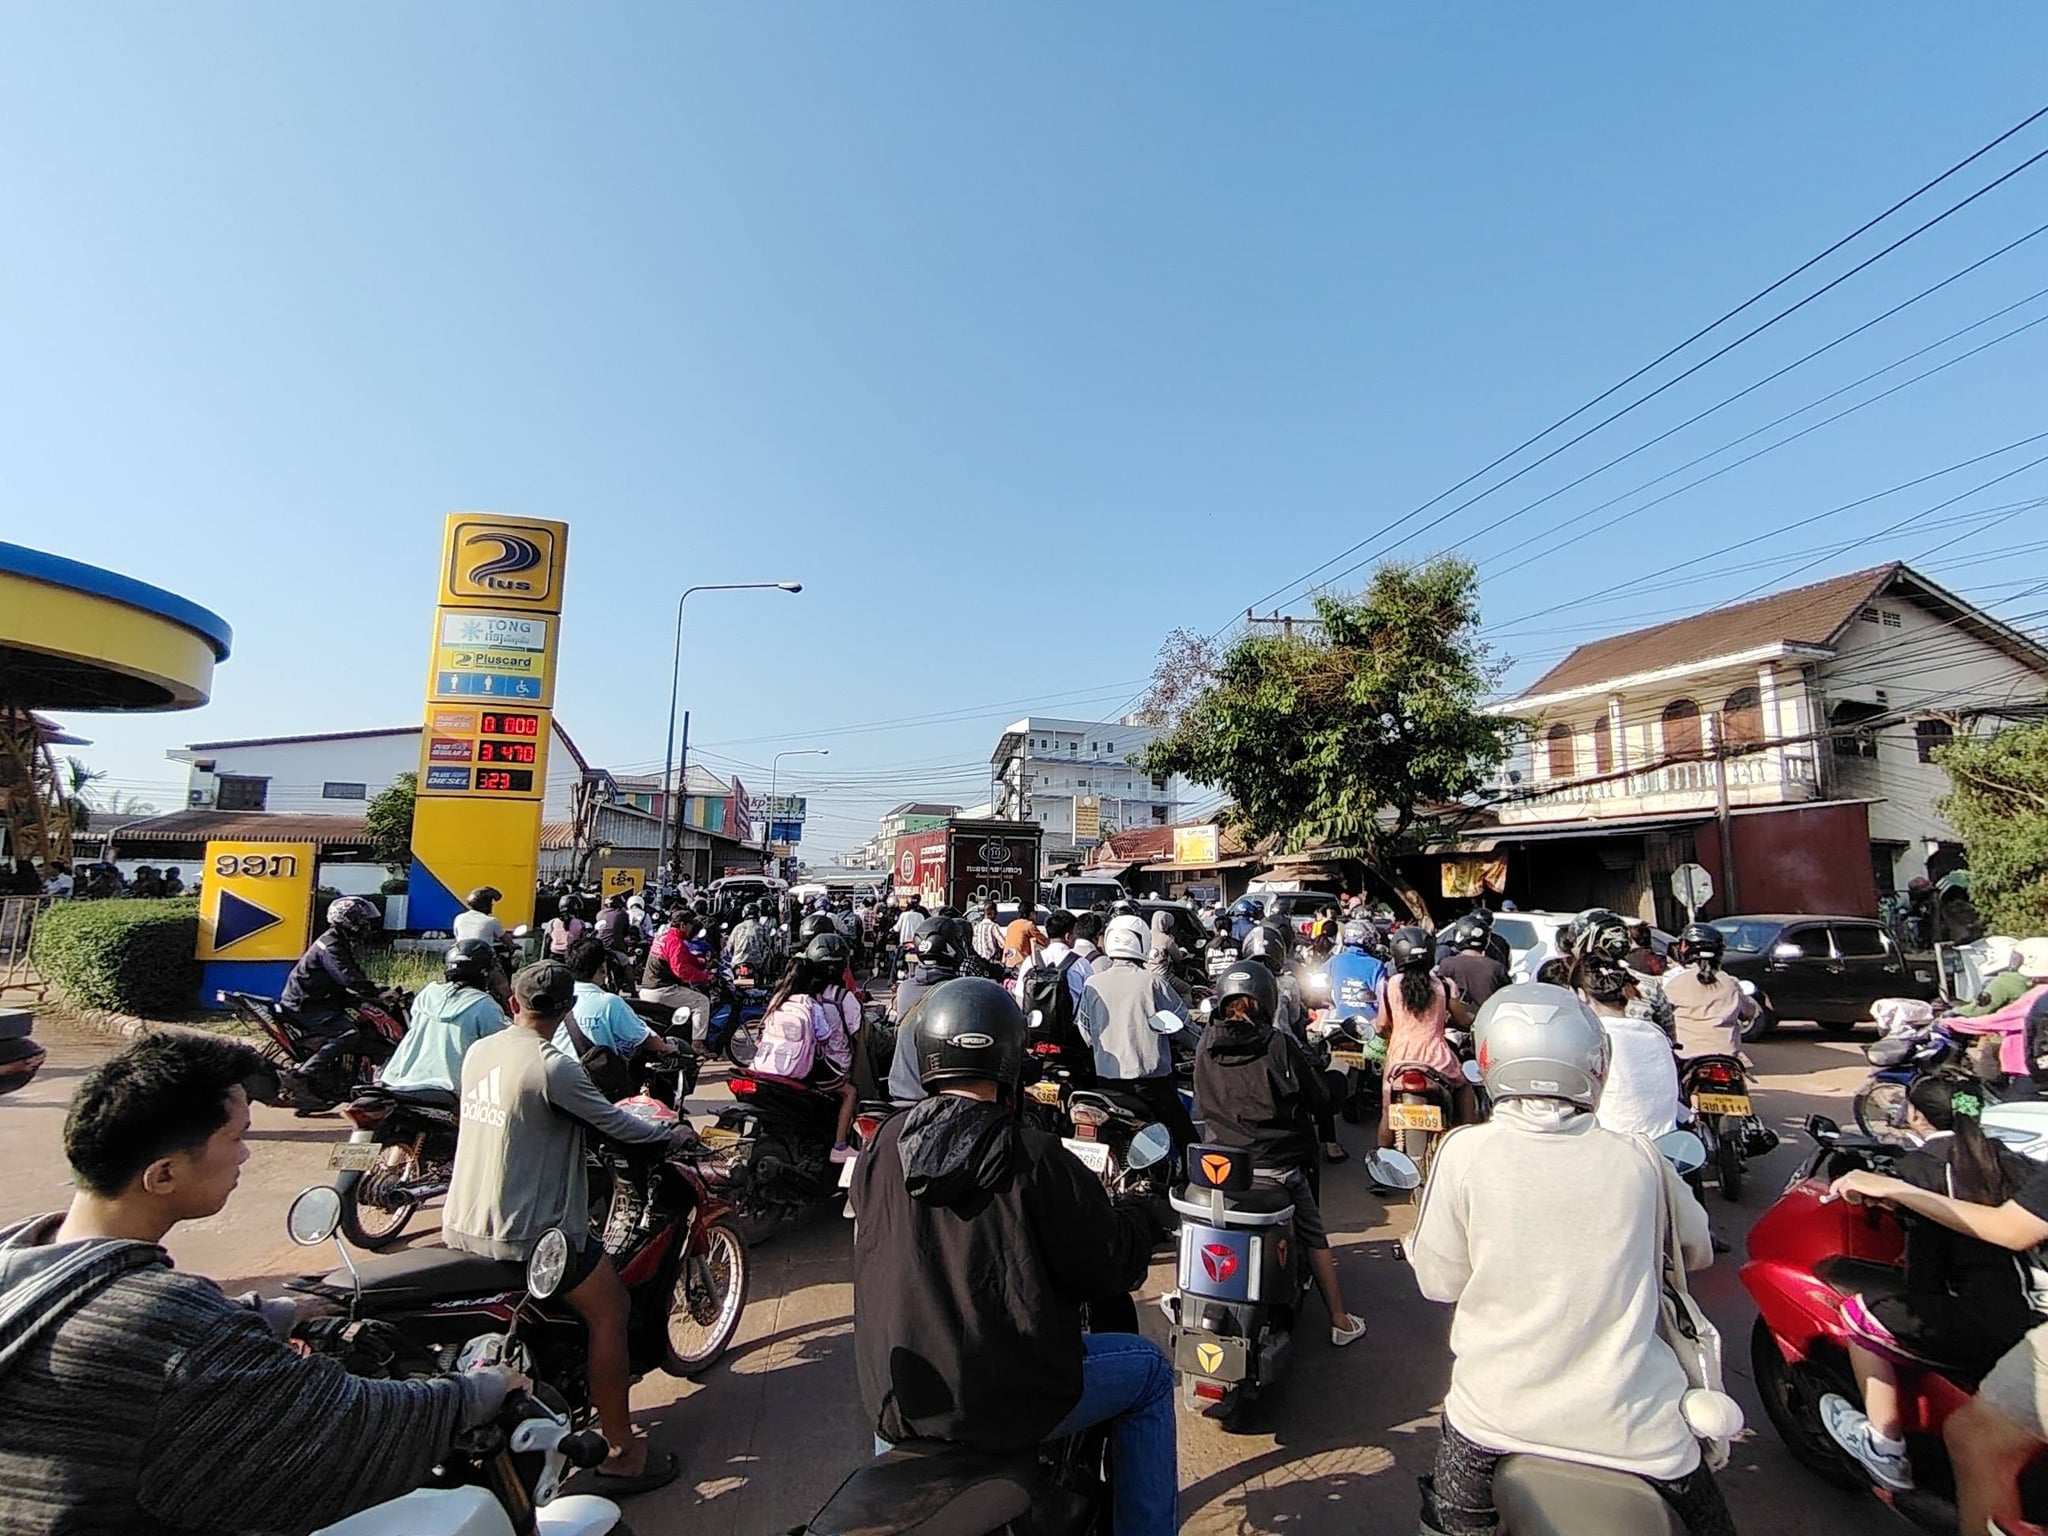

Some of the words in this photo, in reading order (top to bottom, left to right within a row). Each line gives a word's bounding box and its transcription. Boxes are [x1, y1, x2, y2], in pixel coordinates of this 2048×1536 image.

[487, 619, 531, 633] TONG
[476, 653, 532, 667] Pluscard
[428, 777, 469, 785] DIESEL
[215, 854, 297, 877] ອອກ
[463, 1100, 506, 1128] adidas
[1410, 1116, 1439, 1128] 3909
